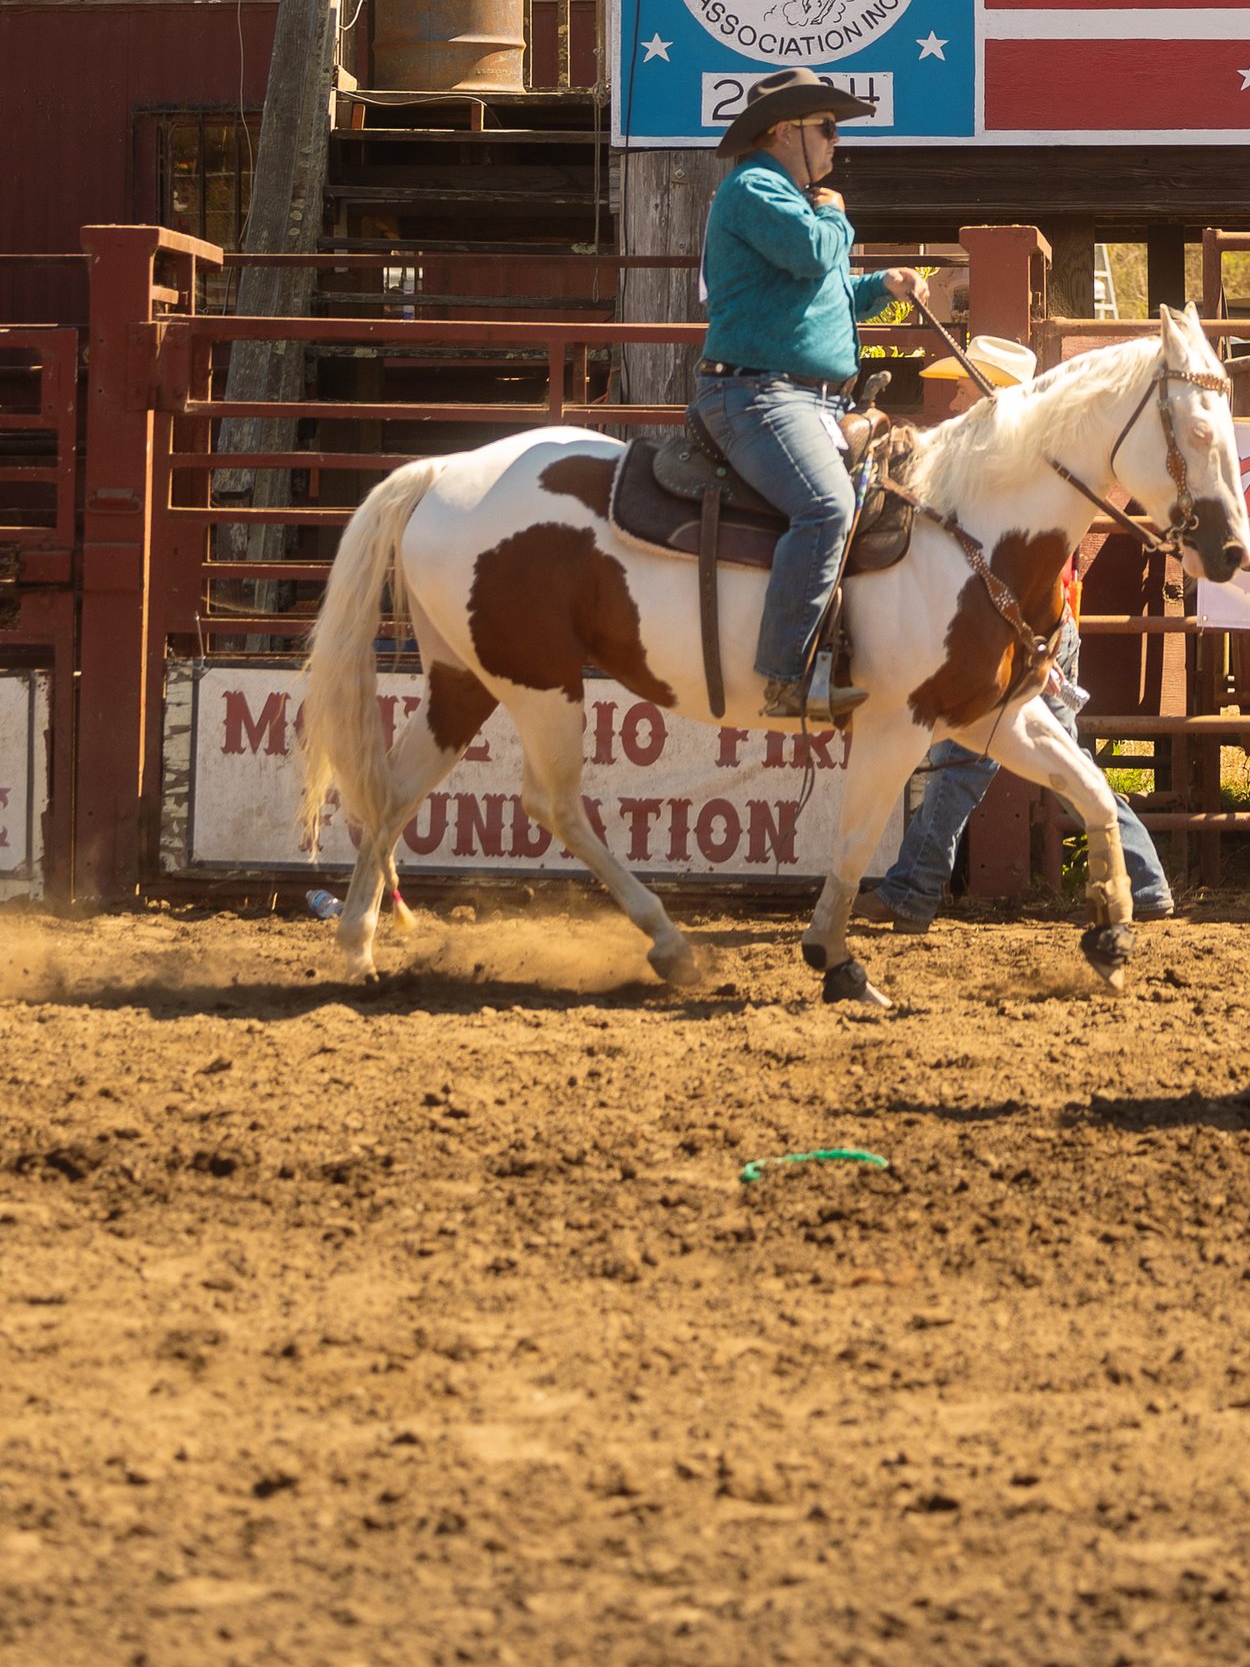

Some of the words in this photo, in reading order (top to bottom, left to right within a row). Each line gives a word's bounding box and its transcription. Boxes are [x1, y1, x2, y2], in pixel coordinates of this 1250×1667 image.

[712, 76, 880, 121] 24
[583, 701, 669, 767] IO
[715, 726, 851, 770] FIR
